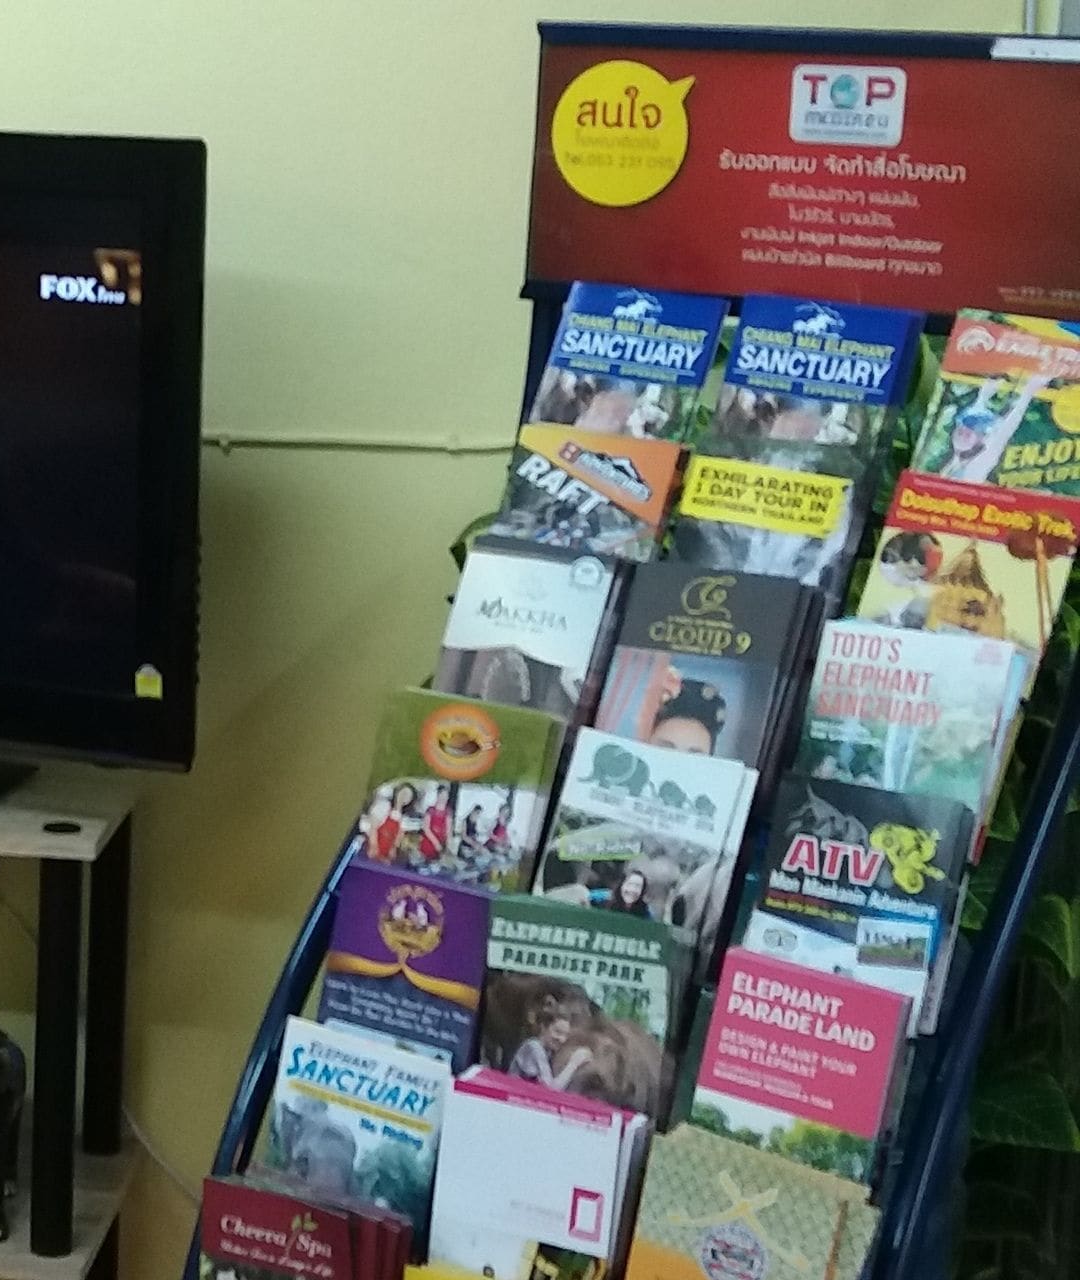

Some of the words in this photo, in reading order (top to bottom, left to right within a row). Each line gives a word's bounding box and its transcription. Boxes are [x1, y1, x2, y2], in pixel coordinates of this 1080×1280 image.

[576, 85, 663, 129] สนใจ
[39, 273, 98, 304] FOX
[561, 327, 705, 371] SANCTUARY
[736, 343, 892, 389] SANCTUARY
[516, 452, 611, 516] RAFT
[754, 489, 804, 510] TOUR
[735, 630, 753, 655] 9
[830, 630, 903, 664] TOTO'S
[822, 660, 935, 697] ELEPHANT
[814, 691, 943, 727] SANCTUARY
[780, 832, 886, 887] ATV
[490, 916, 591, 950] ELEPHANT
[591, 930, 662, 961] JUNGLE
[502, 947, 593, 975] PARADISE
[595, 960, 646, 984] PARK
[731, 969, 844, 1020] ELEPHANT
[727, 992, 812, 1036] PARADE
[814, 1016, 877, 1053] LAND
[285, 1045, 436, 1117] SANCTUARY
[295, 1233, 333, 1260] Spa
